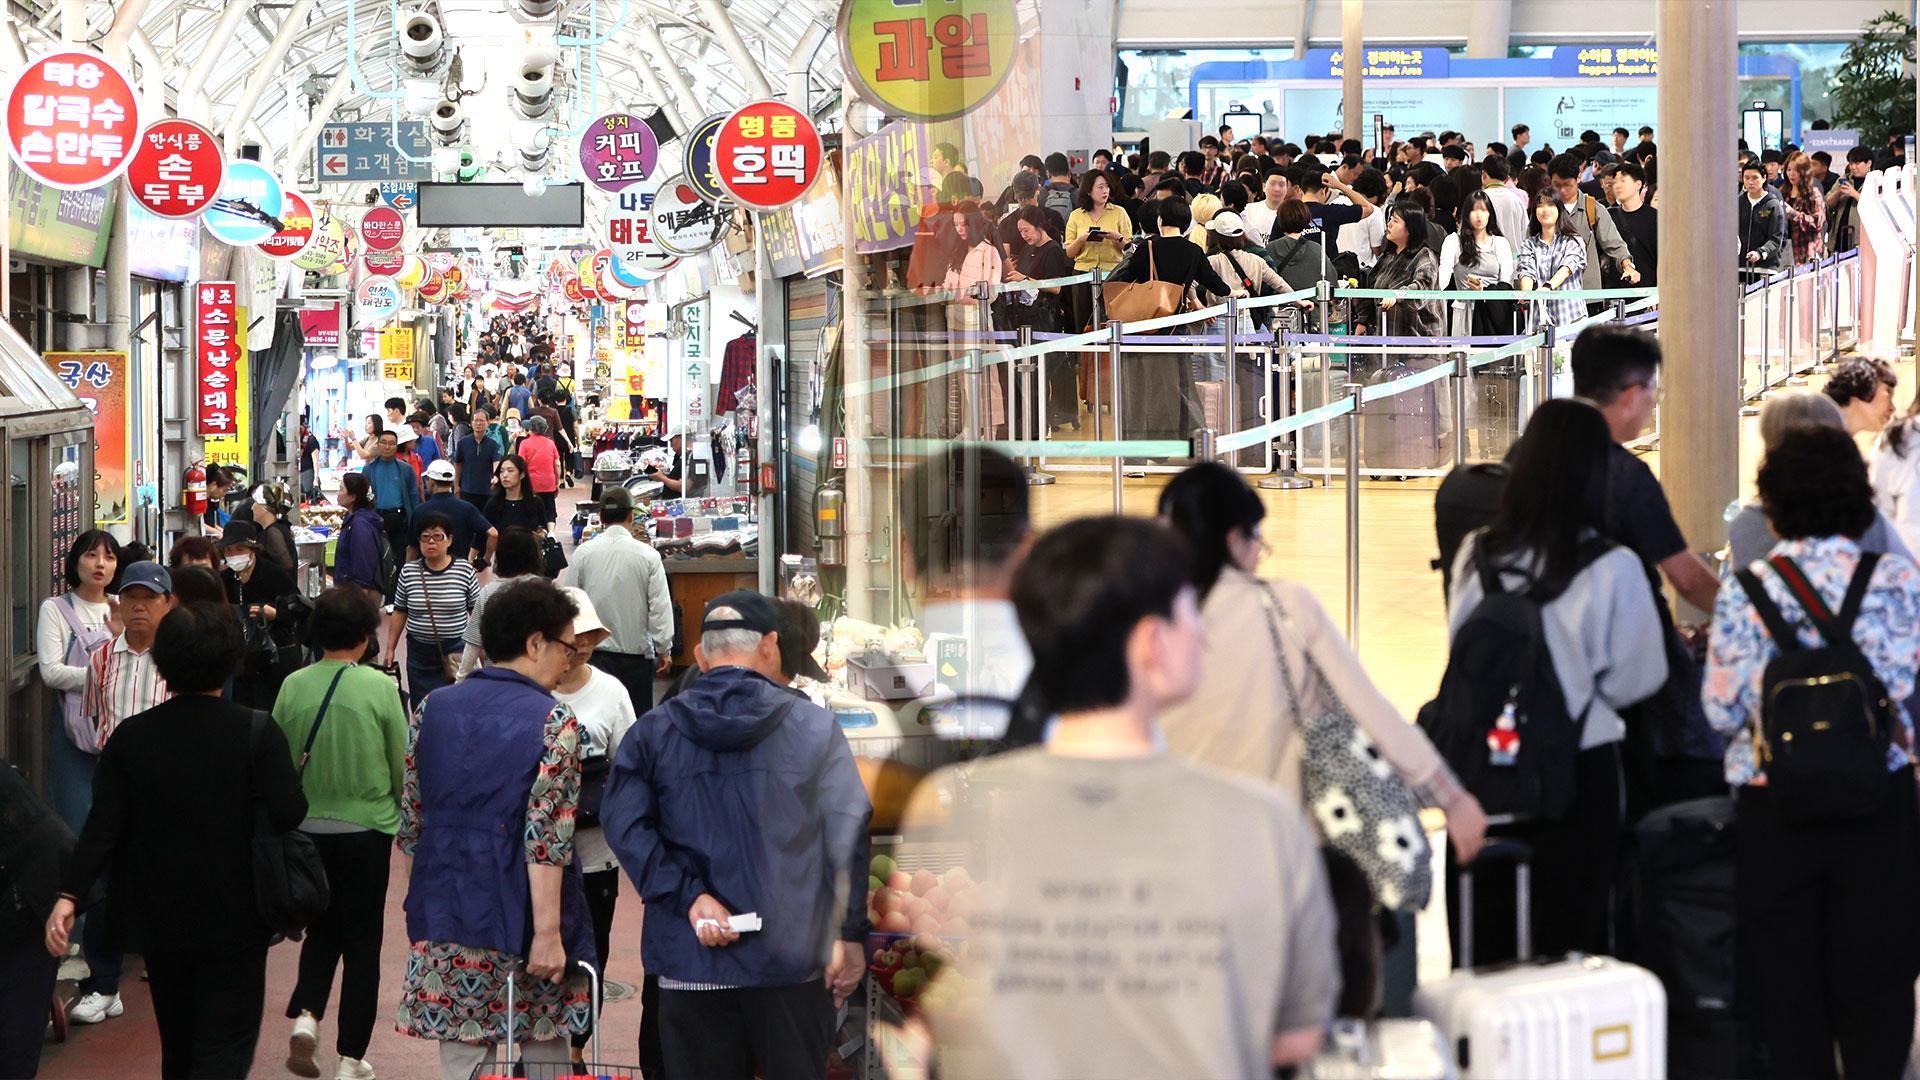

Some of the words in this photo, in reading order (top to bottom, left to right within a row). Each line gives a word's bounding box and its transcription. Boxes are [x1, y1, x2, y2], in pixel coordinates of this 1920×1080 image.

[873, 13, 992, 82] 과일
[604, 116, 629, 130] 성지
[739, 115, 796, 138] 명품
[20, 131, 123, 166] 손만두
[148, 132, 202, 151] 한식품
[595, 132, 641, 154] 커피
[157, 153, 193, 181] 손
[597, 161, 645, 182] 호프
[731, 144, 806, 185] 호떡
[144, 184, 205, 206] 두부
[626, 251, 645, 261] 2F
[200, 289, 232, 305] 원조
[362, 297, 392, 308] 태권도
[686, 306, 702, 380] 잔치국수
[58, 360, 113, 389] 국산
[385, 366, 412, 378] 김치
